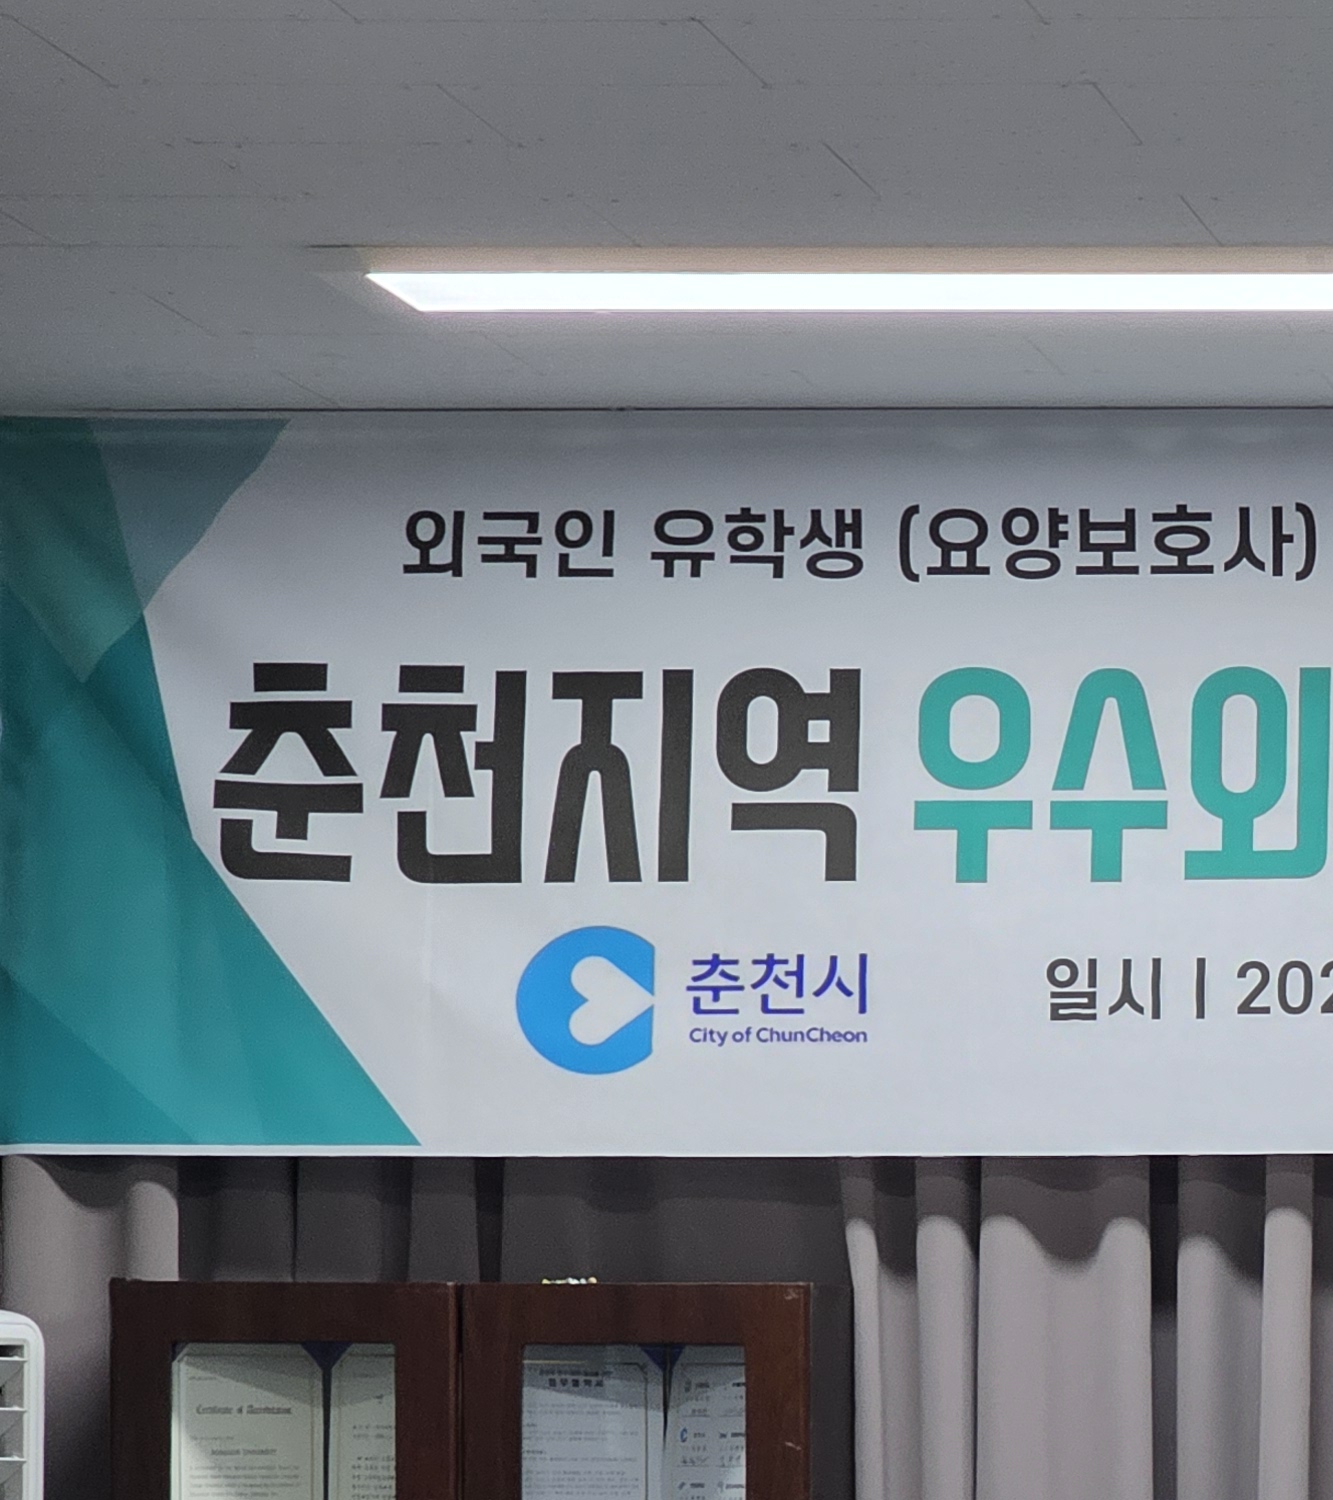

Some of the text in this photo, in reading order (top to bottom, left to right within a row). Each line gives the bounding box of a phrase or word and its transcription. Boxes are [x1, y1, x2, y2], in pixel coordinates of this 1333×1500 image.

[404, 511, 615, 578] 외국인
[652, 509, 864, 579] 유학생
[901, 504, 1317, 583] (요양보호사)
[213, 664, 862, 884] 춘천지역
[687, 954, 869, 1016] 춘천시
[1048, 958, 1162, 1021] 일시
[690, 1027, 869, 1048] City of ChunCheon
